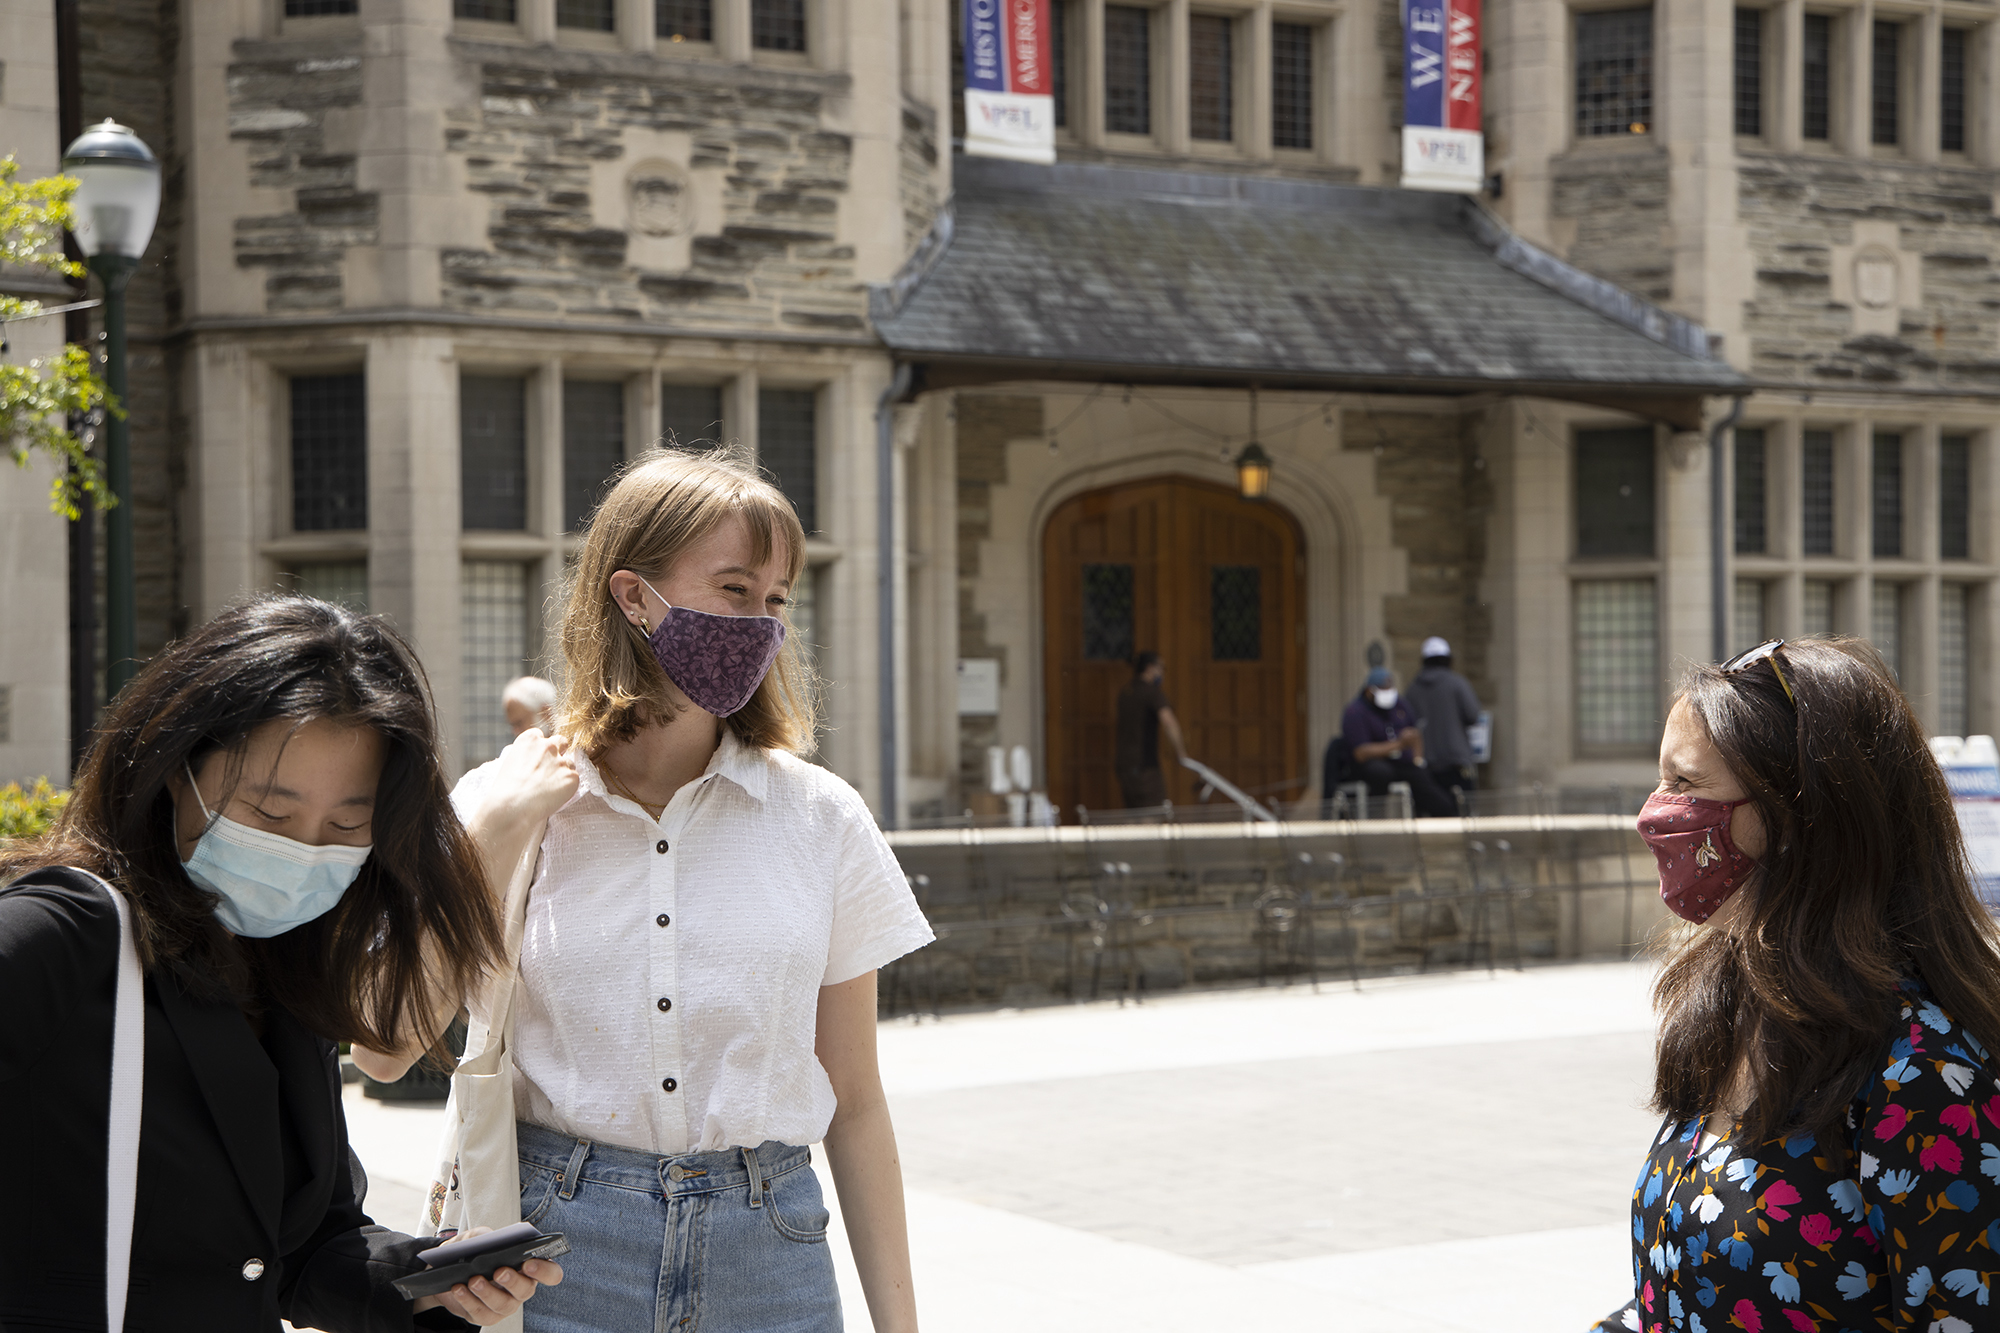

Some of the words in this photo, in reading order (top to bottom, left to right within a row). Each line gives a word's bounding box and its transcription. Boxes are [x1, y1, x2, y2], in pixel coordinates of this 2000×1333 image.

[1013, 0, 1040, 90] AMERIC
[1410, 6, 1442, 90] WE
[1450, 8, 1476, 102] NEW
